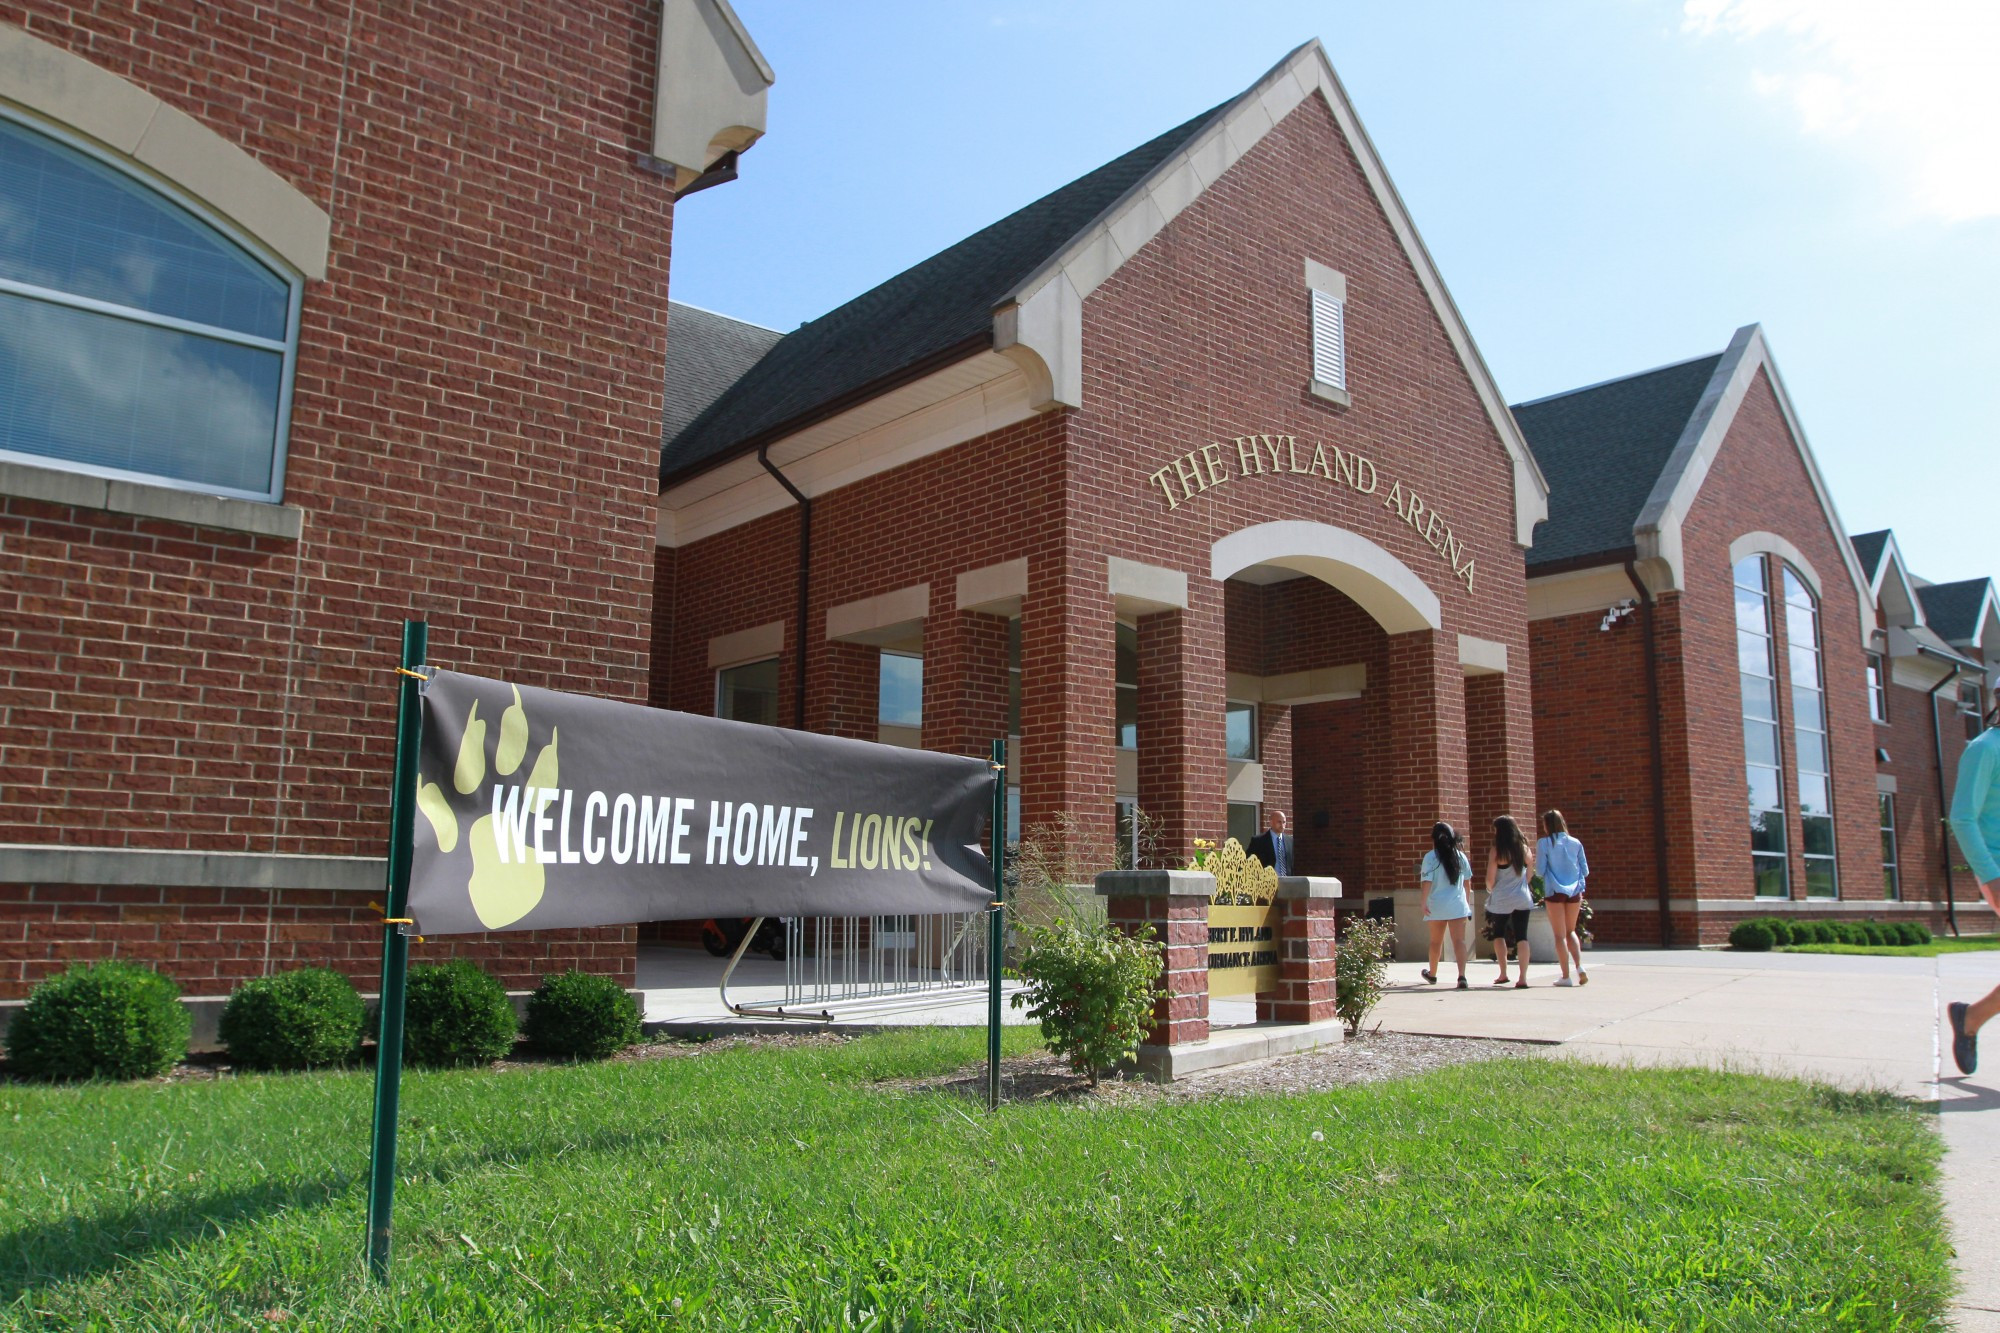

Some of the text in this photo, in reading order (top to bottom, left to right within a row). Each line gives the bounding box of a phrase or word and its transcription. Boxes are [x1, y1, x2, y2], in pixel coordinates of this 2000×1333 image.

[1149, 434, 1475, 594] THE HYLAND ARENA
[491, 784, 933, 876] WELCOME HOME, LIONS!
[1239, 926, 1273, 942] HYLAND
